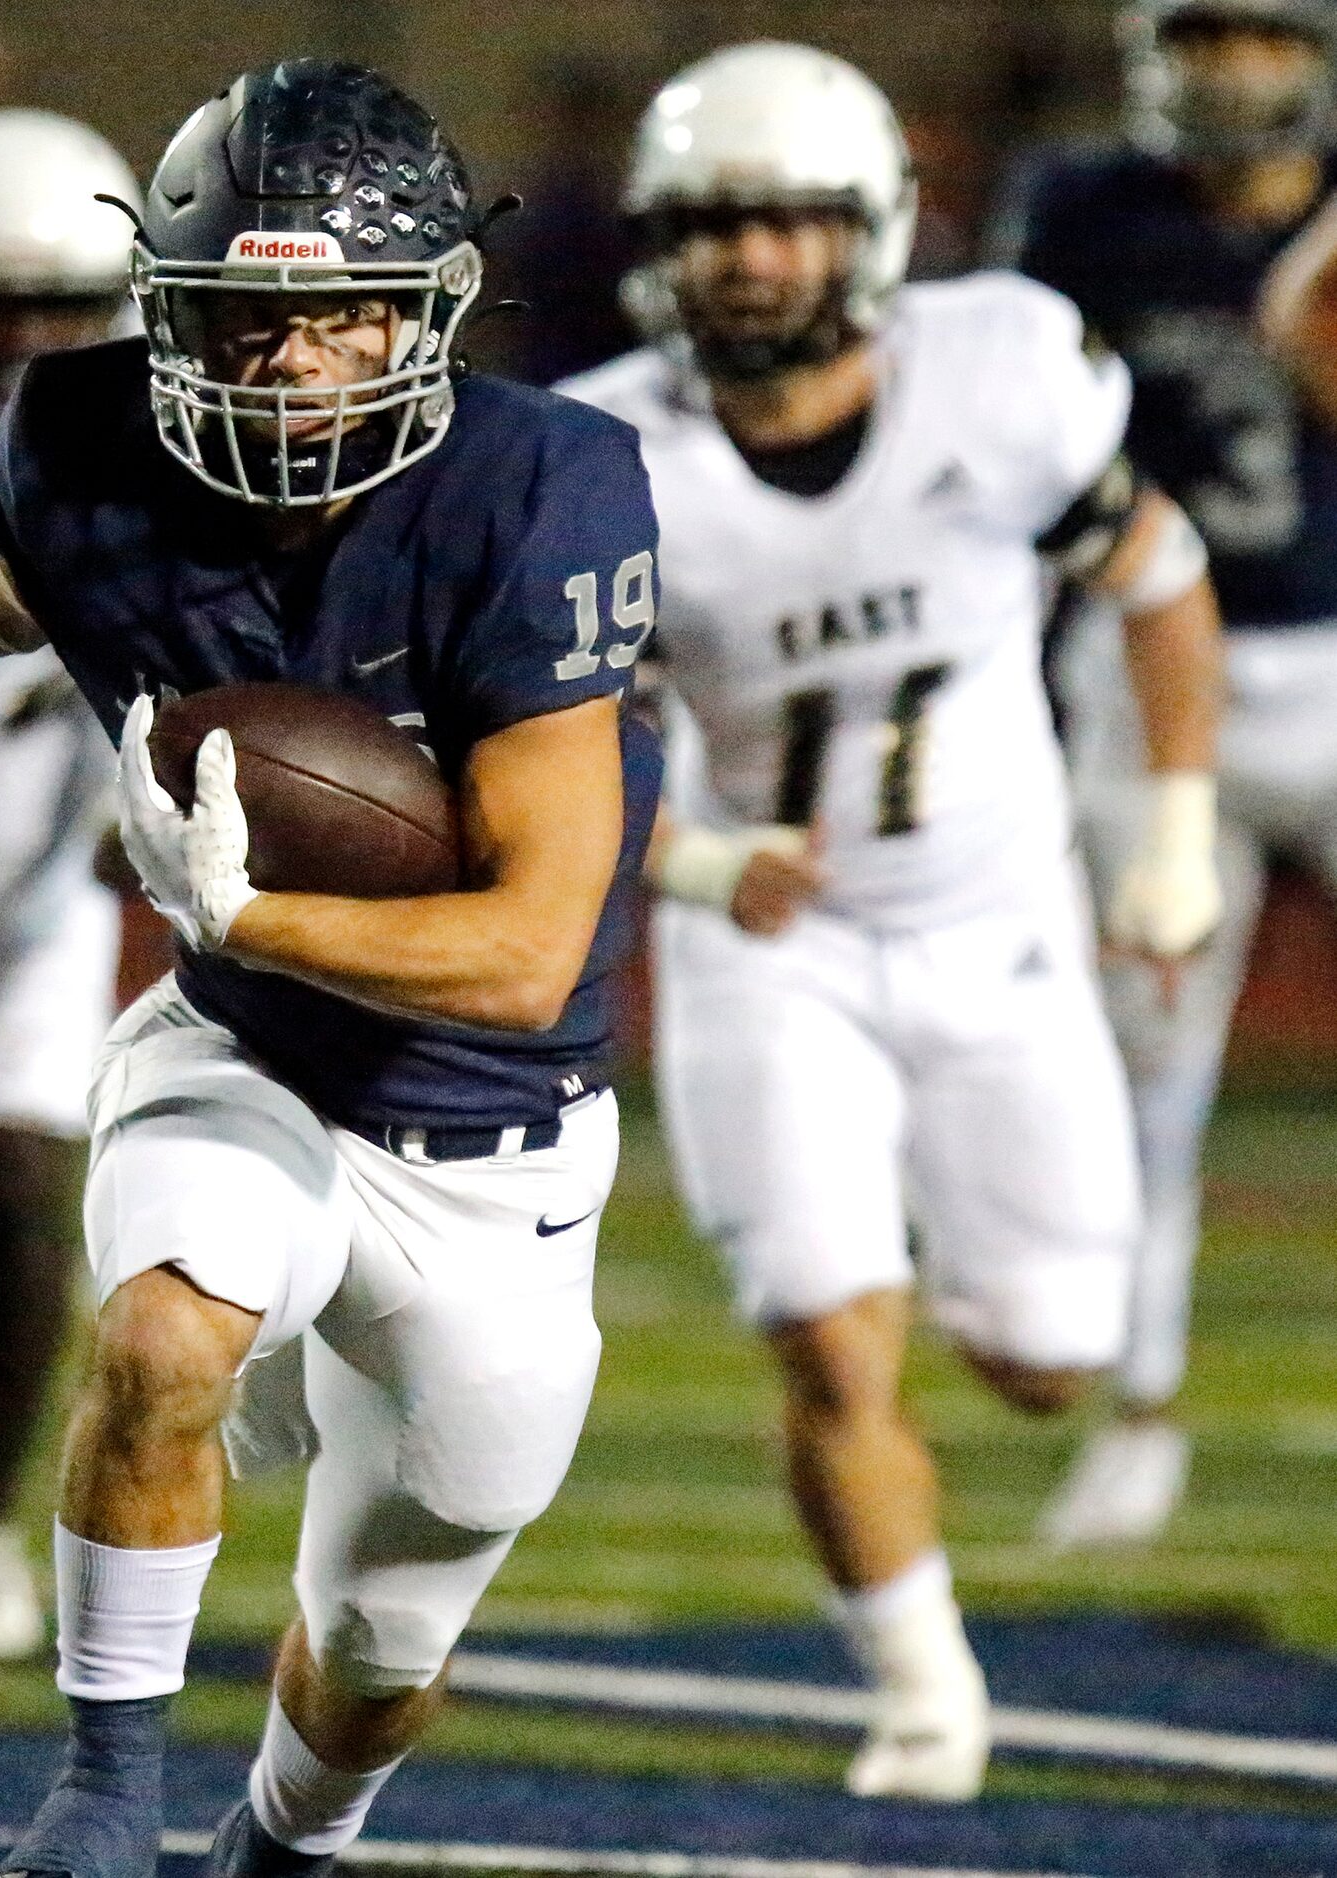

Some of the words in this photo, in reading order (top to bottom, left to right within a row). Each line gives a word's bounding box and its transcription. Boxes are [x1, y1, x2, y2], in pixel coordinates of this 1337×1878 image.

[240, 239, 327, 258] Riddell
[553, 550, 655, 681] 19
[774, 582, 920, 664] EAST
[562, 1074, 585, 1098] M
